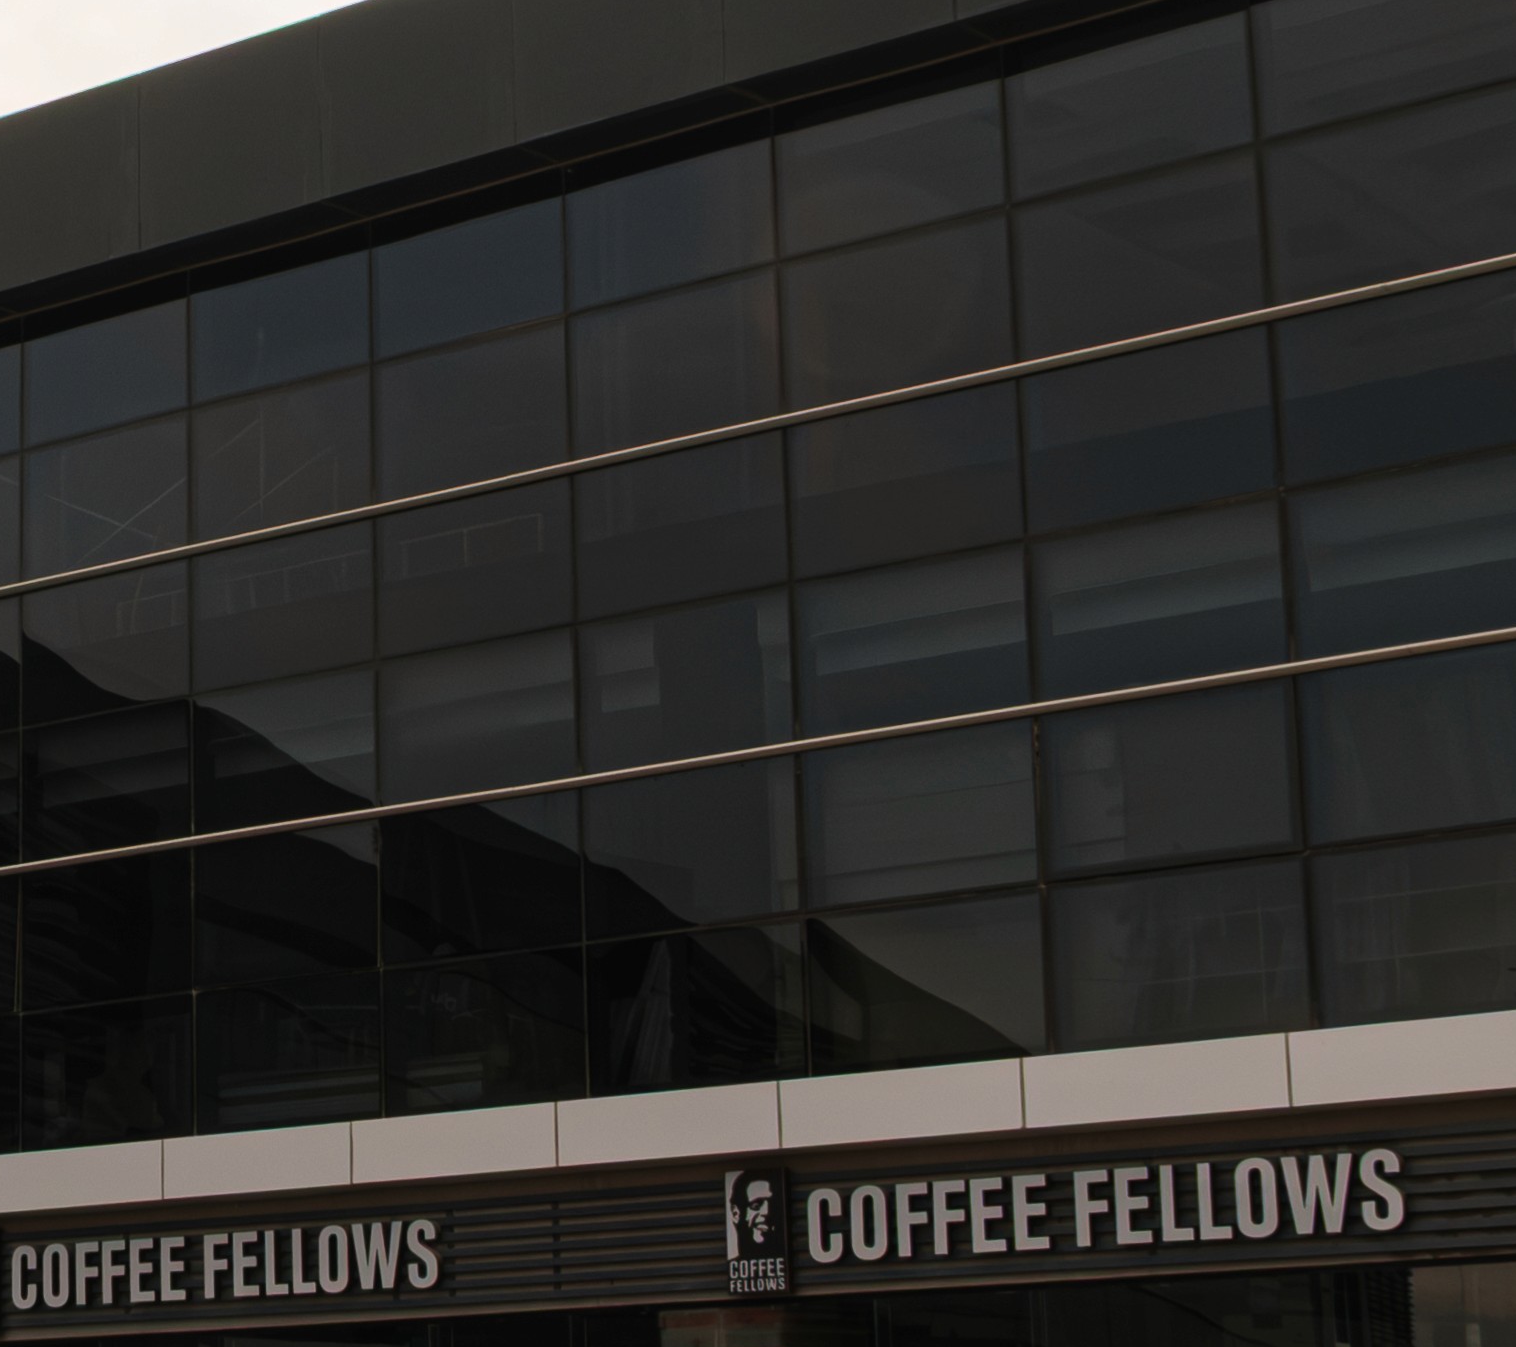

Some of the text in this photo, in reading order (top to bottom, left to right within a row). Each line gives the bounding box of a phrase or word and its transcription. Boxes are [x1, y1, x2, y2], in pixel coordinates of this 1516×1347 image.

[806, 1148, 1406, 1264] COFFEE FELLOWS
[11, 1219, 439, 1310] COFFEE FELLOWS
[729, 1257, 785, 1279] COFFEE
[729, 1277, 786, 1293] FELLOWS
